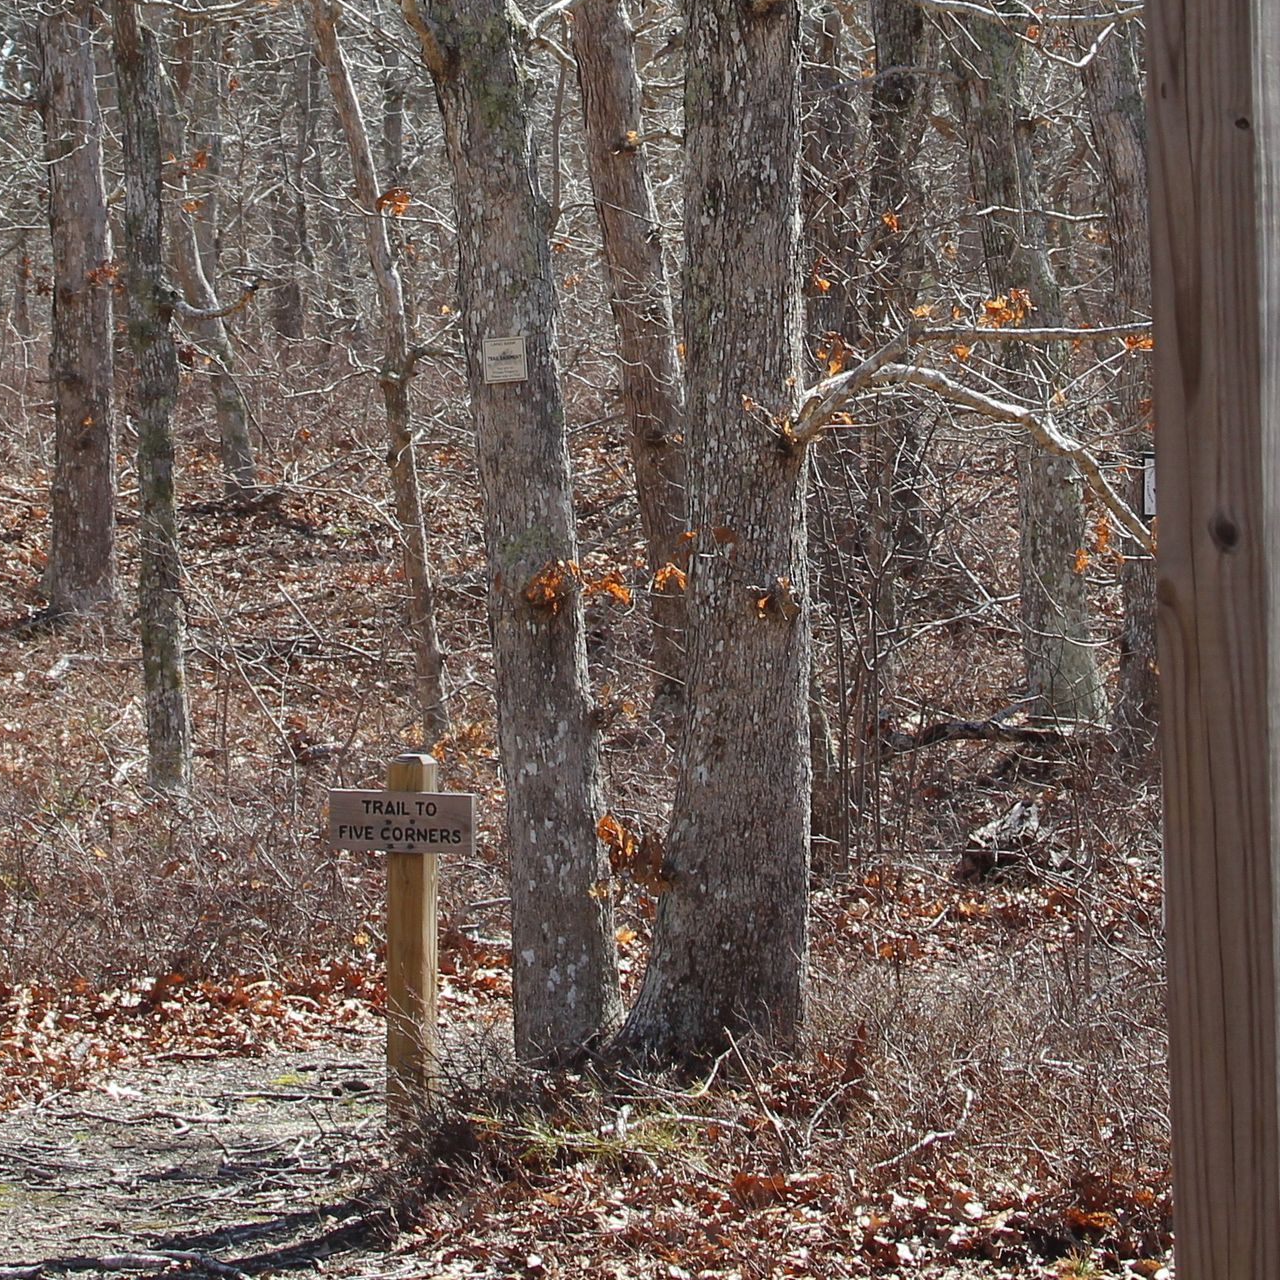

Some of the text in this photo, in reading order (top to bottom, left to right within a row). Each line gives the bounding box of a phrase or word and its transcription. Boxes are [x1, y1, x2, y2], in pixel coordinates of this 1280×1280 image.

[361, 799, 438, 817] TRAIL TO
[338, 824, 462, 845] FIVE CORNERS
